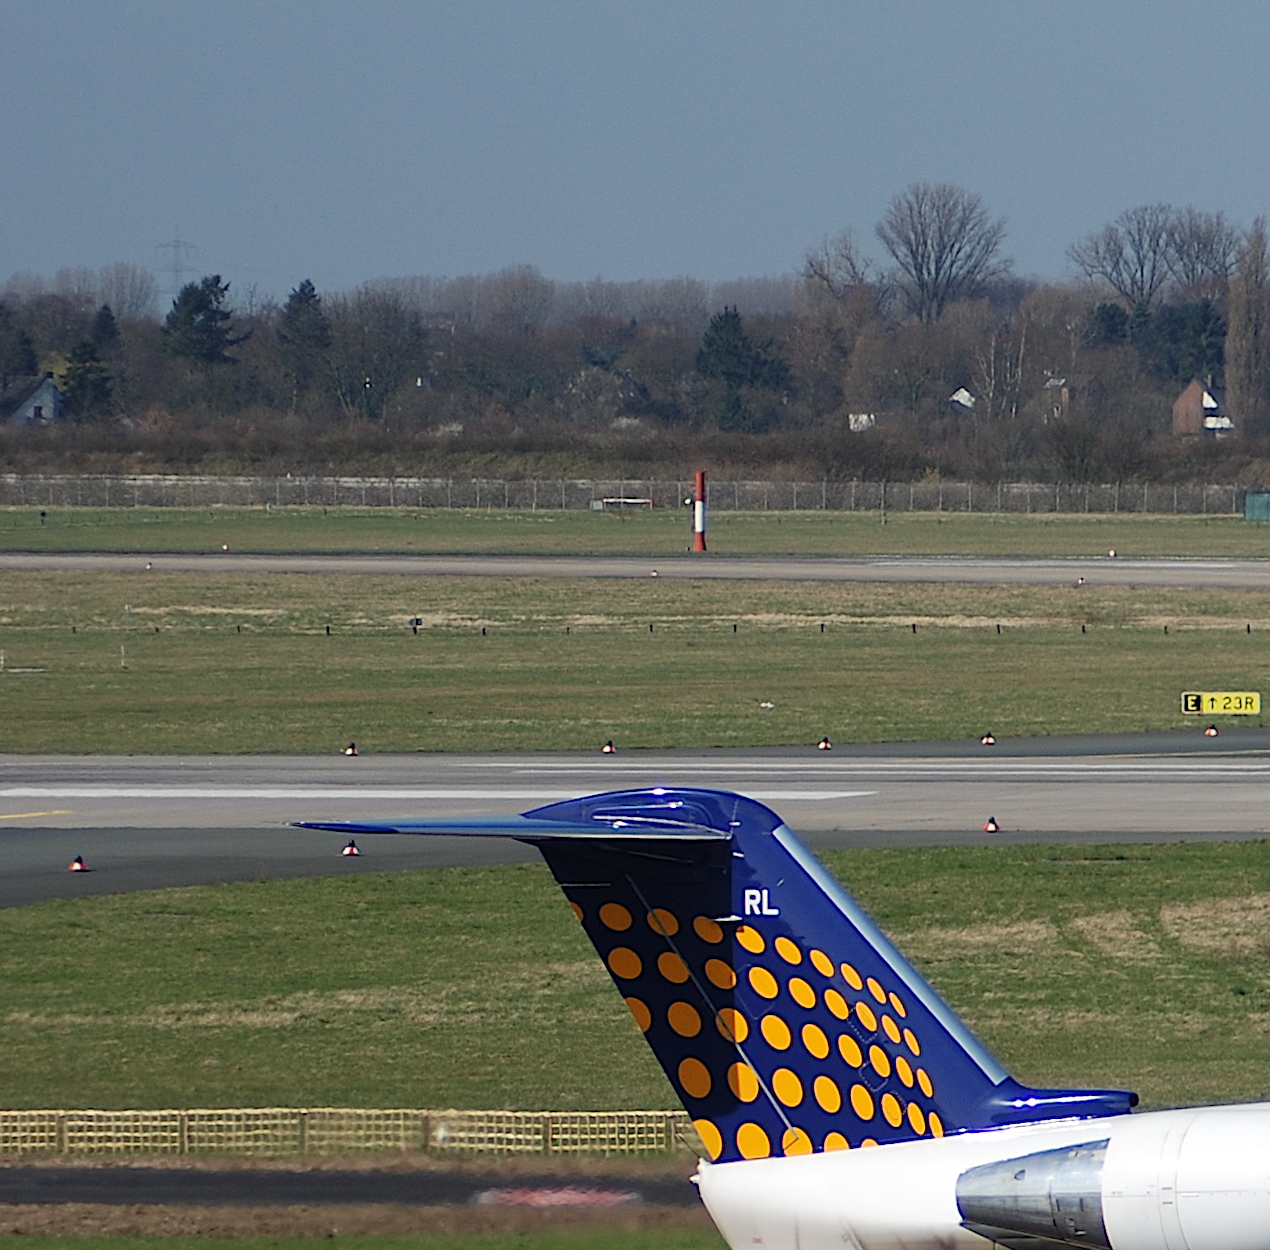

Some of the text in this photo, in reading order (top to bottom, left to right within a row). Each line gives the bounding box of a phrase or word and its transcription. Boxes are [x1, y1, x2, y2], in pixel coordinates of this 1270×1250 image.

[1187, 695, 1254, 711] E 23R
[744, 889, 779, 915] RL
